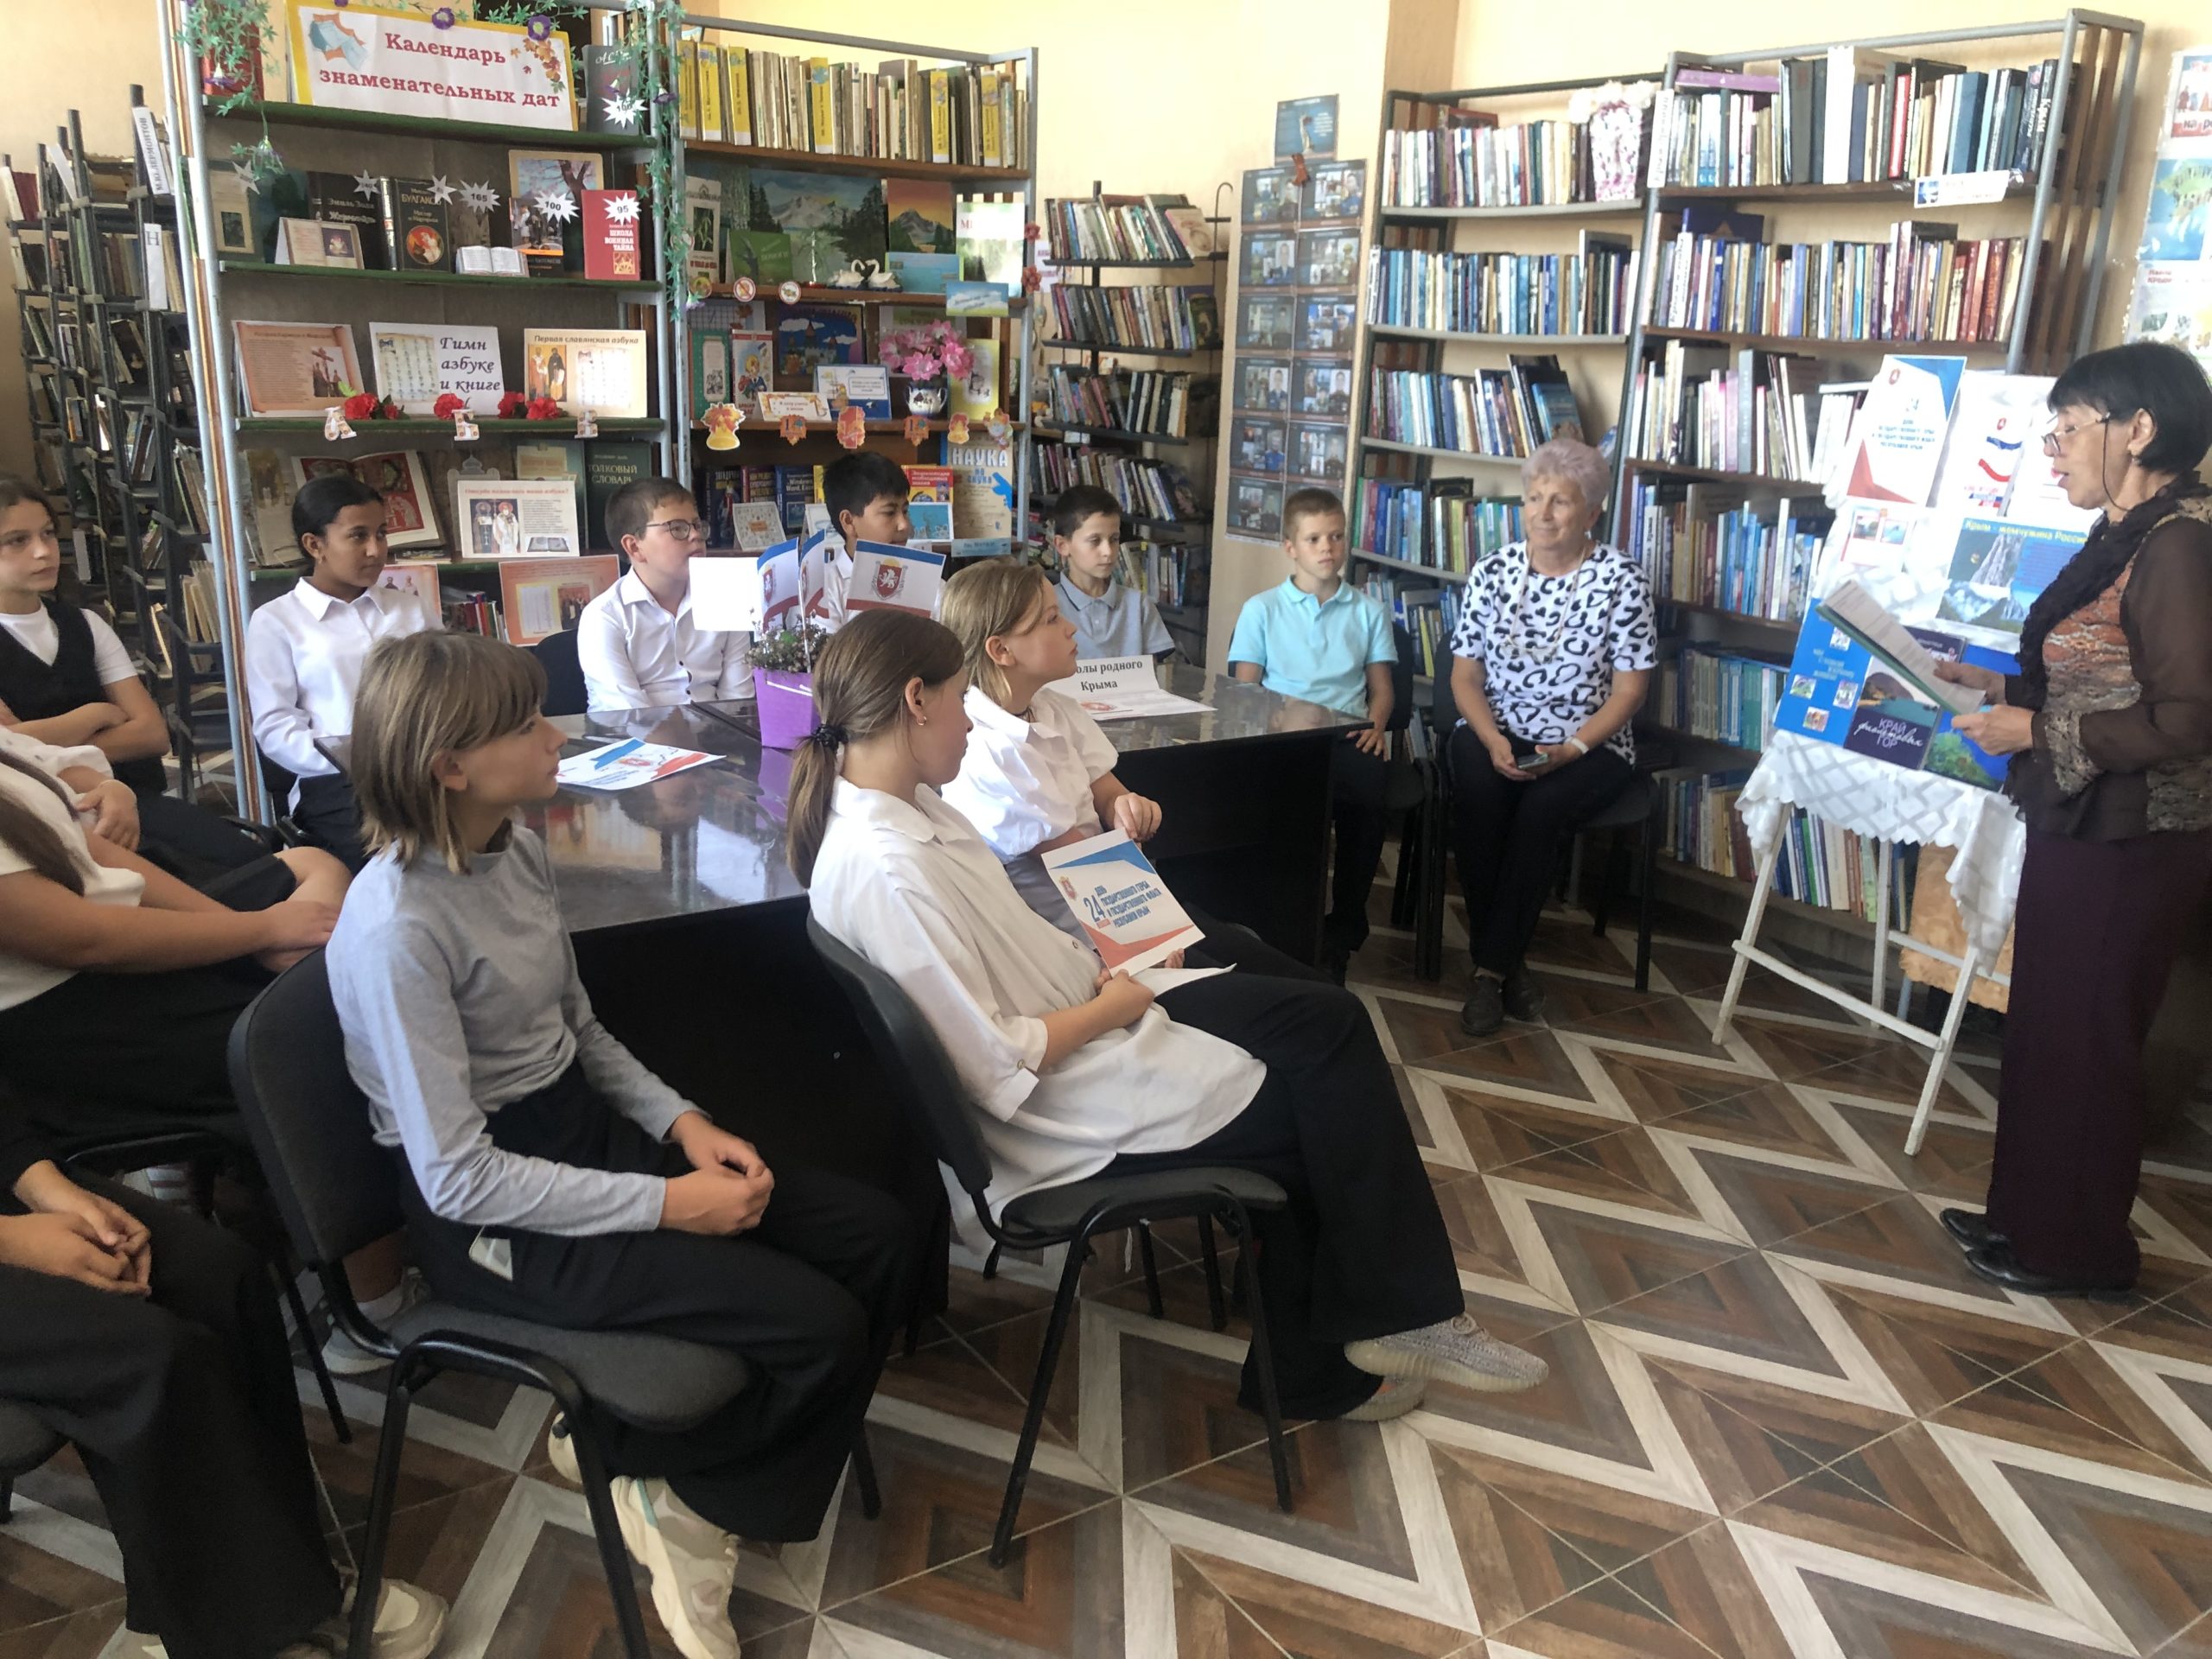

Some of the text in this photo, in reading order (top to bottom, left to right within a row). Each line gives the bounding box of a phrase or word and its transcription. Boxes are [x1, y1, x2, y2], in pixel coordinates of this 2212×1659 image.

[385, 32, 506, 66] Календарь
[319, 67, 561, 109] знаменательных дат
[470, 193, 487, 202] 165
[544, 201, 562, 212] 100
[616, 205, 630, 213] 95
[145, 231, 160, 246] Н
[440, 337, 488, 351] Гимн
[534, 334, 564, 343] Первая
[611, 336, 639, 345] азбука
[441, 356, 495, 374] азбуке
[440, 379, 501, 394] и книге
[952, 448, 1009, 467] НАУКА
[588, 464, 638, 474] ТОЛКОВЫЙ
[1100, 660, 1143, 675] родного
[1080, 680, 1118, 693] Крыма
[1878, 718, 1907, 734] КРАЙ
[1083, 894, 1106, 923] 24
